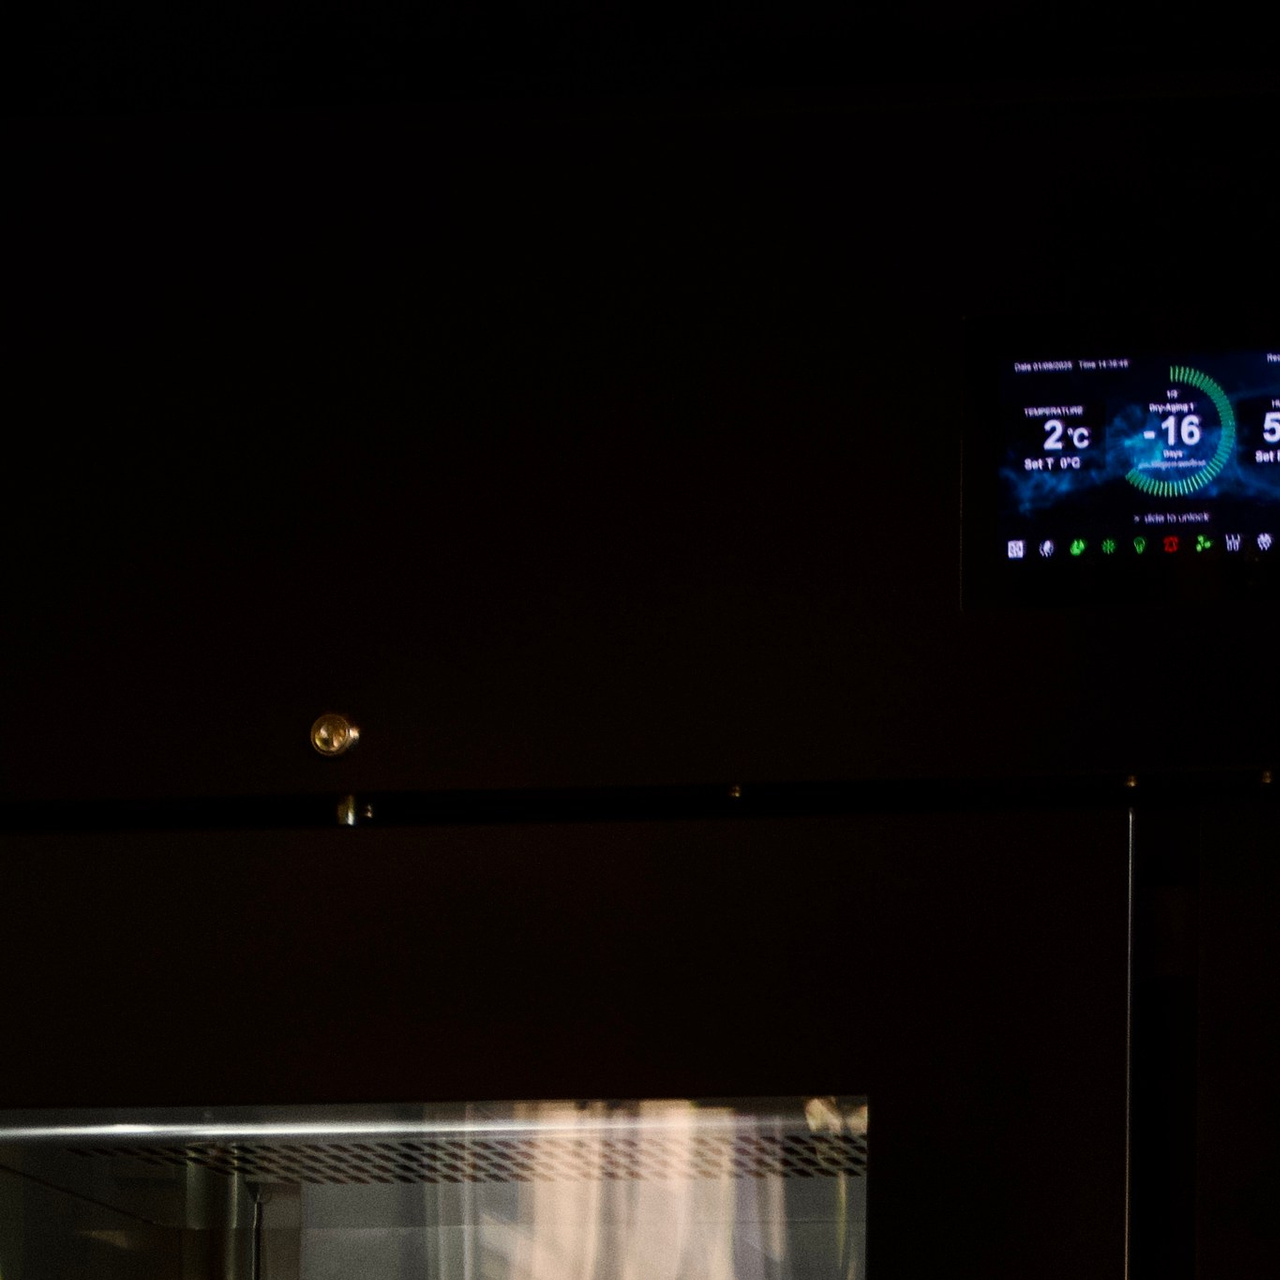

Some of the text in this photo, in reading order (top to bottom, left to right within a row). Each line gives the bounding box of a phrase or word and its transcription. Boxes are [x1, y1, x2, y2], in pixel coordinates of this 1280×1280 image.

[1024, 405, 1084, 417] TEMPERATURE
[1043, 419, 1063, 450] 2
[1143, 415, 1201, 446] -16
[1255, 450, 1274, 463] Set
[1024, 457, 1043, 471] Set
[1045, 457, 1054, 471] T
